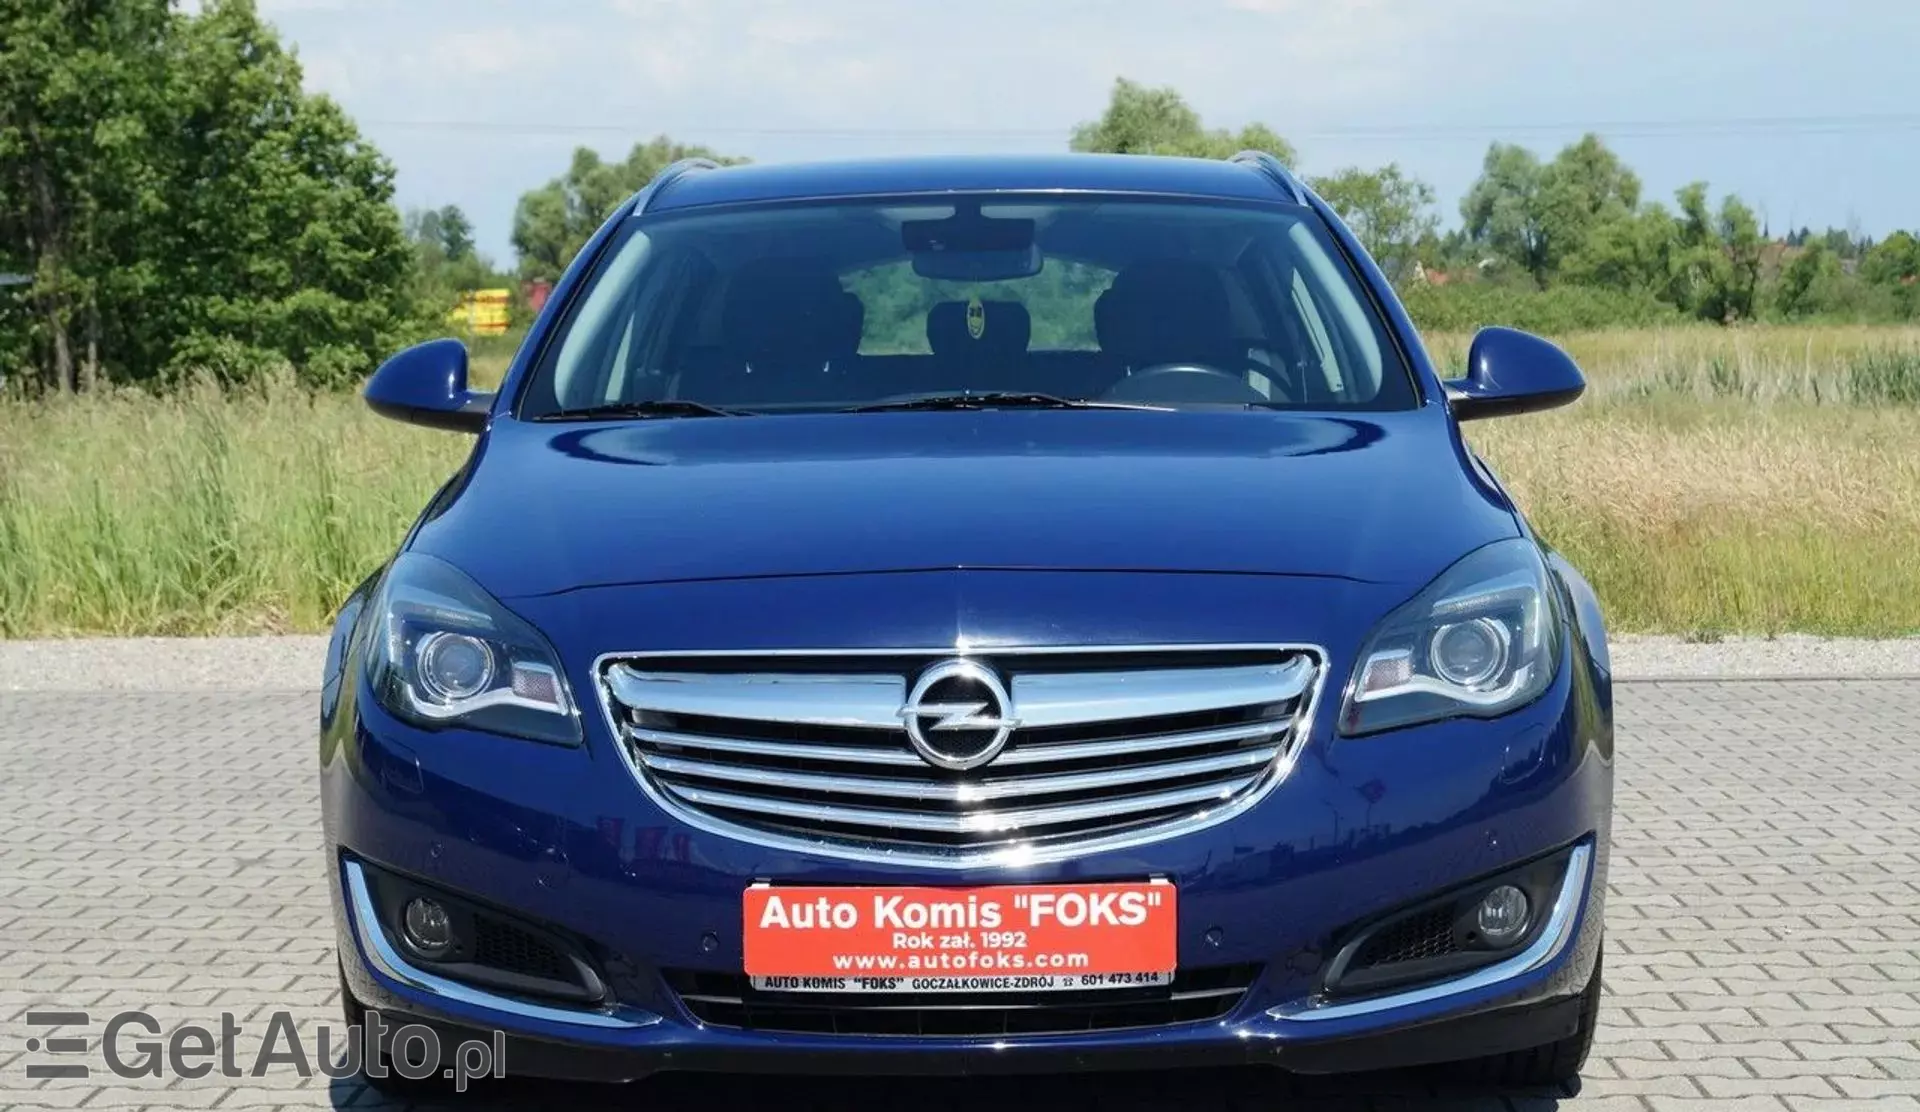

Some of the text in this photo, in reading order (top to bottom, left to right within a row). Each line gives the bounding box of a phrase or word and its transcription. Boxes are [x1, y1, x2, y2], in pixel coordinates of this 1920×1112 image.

[759, 892, 1161, 929] Auto Komis "FOKS"
[892, 931, 1028, 949] Rok zał. 1992
[832, 952, 1089, 970] www.autofoks.com
[764, 976, 799, 989] AUTO
[802, 976, 846, 989] KOMIS
[912, 976, 1055, 990] GOCZAŁKOWICE-ZDRÓJ
[1081, 973, 1104, 986] 601
[1108, 973, 1132, 984] 473
[1135, 971, 1160, 984] 414
